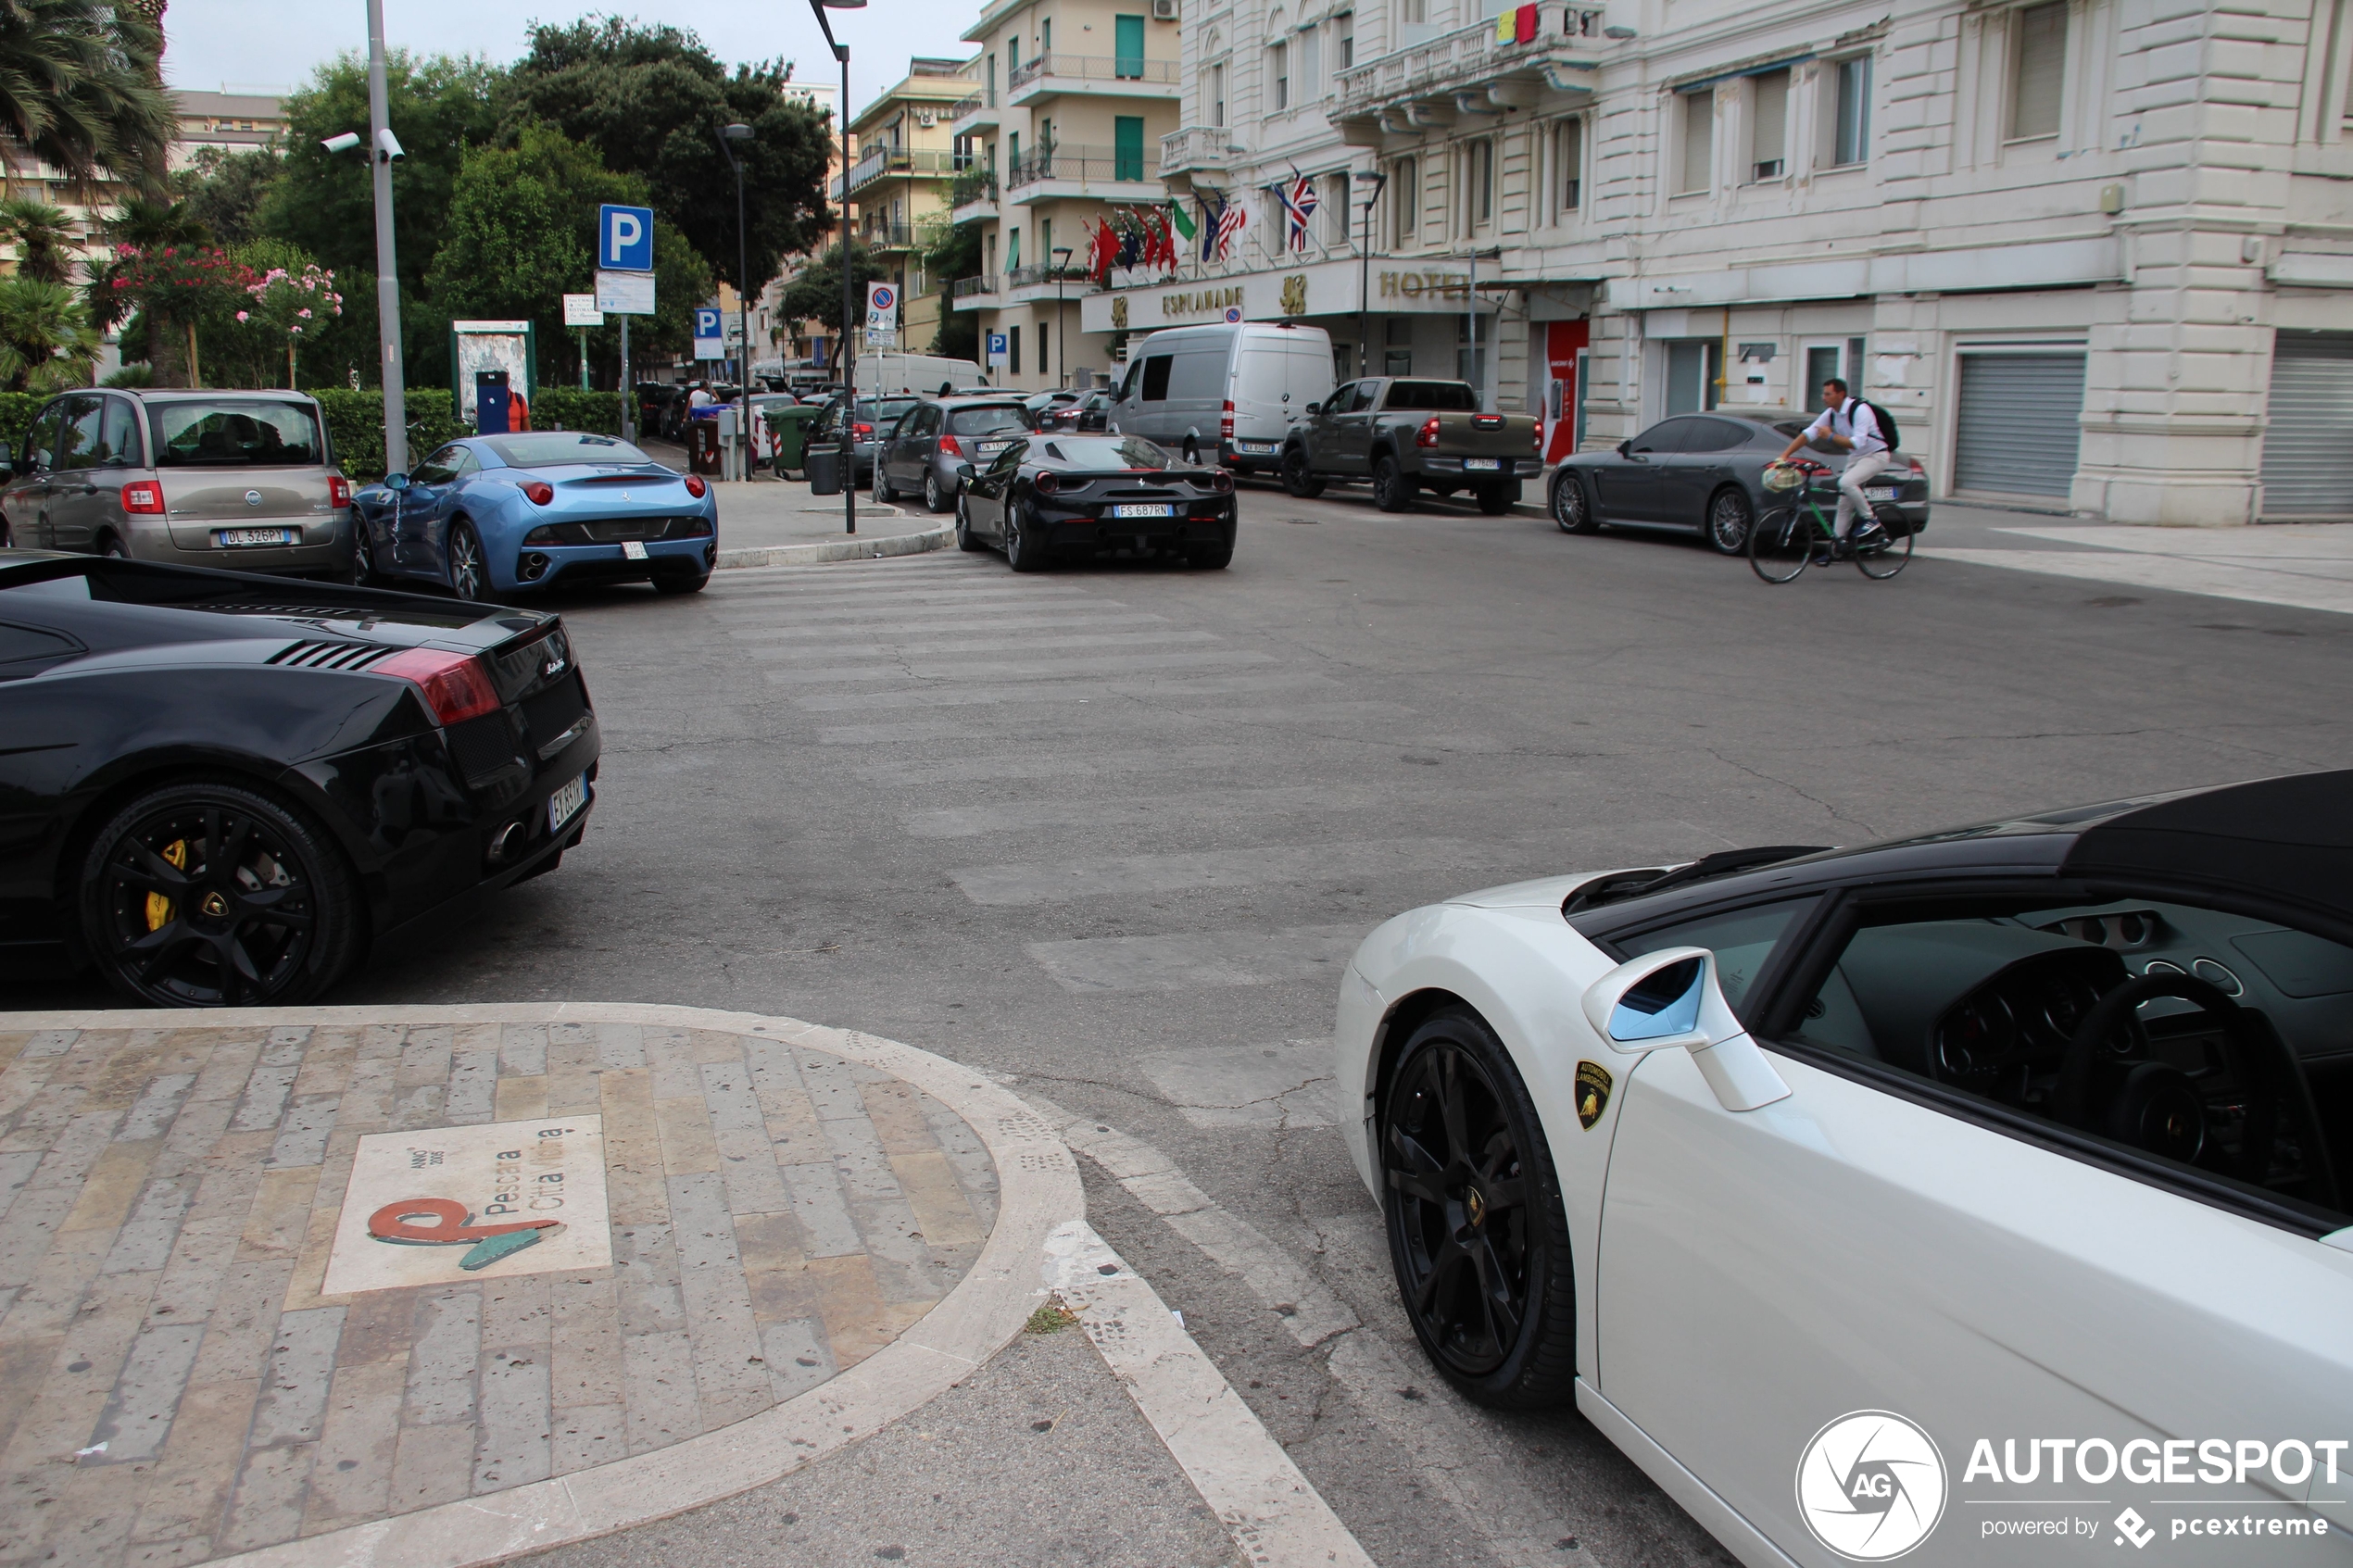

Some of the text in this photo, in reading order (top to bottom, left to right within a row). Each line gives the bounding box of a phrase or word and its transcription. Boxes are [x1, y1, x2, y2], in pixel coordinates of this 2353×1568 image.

[611, 212, 642, 261] P
[1380, 270, 1471, 299] HOTEL
[1164, 286, 1244, 314] ESPLANADE
[698, 311, 717, 335] P
[991, 336, 1003, 352] P
[1120, 505, 1167, 516] FS 687RN
[228, 529, 283, 543] DL 326PY
[1576, 1073, 1610, 1097] LAMBORGHINI
[1580, 1063, 1610, 1085] AUTOMOBILI
[410, 1149, 427, 1169] ANNO
[484, 1149, 522, 1215] Pescara
[528, 1173, 565, 1210] Città
